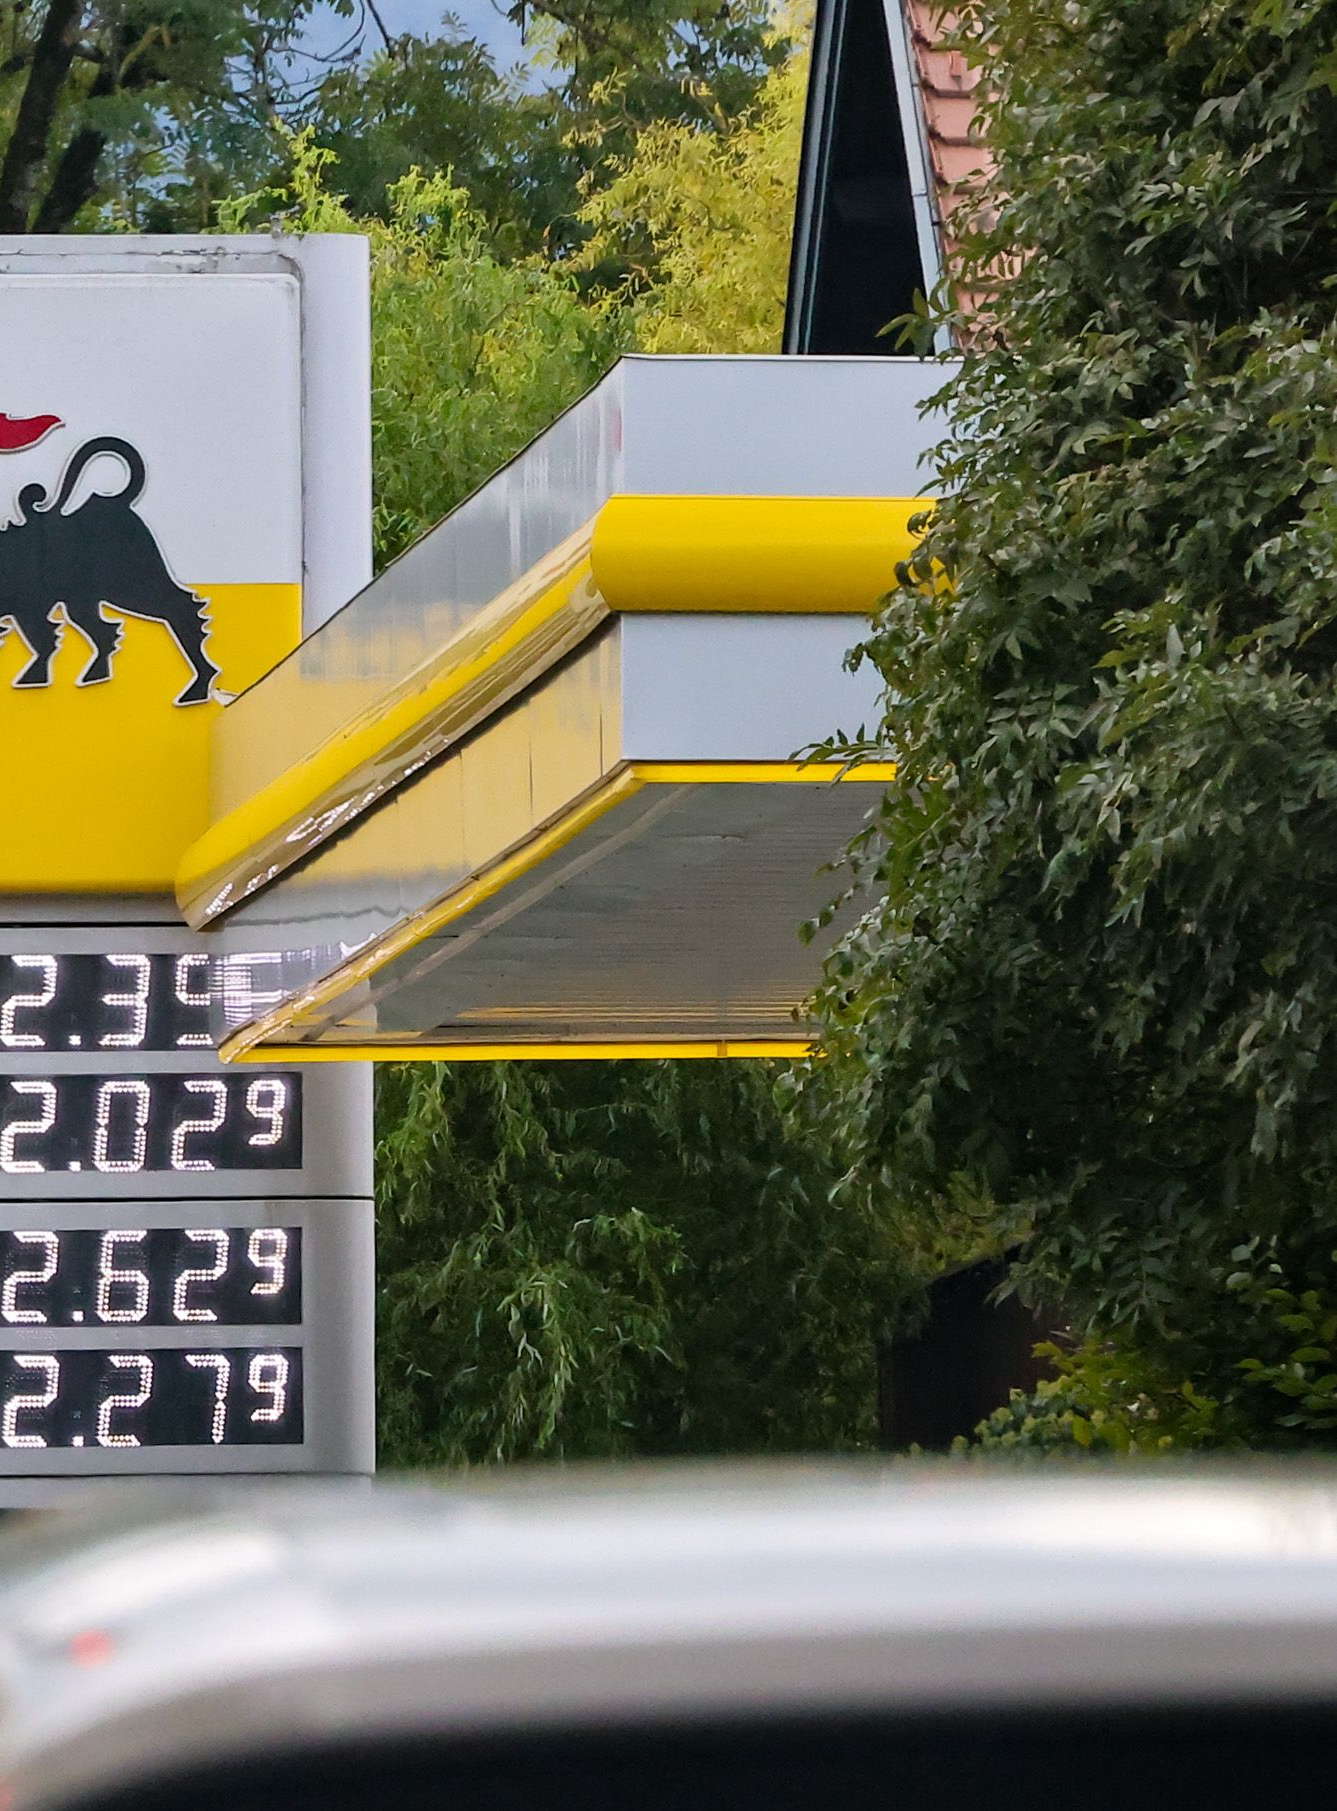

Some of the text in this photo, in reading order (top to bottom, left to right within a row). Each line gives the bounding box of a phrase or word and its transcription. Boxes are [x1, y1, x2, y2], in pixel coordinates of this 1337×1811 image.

[0, 1080, 286, 1172] 2.029
[0, 1230, 288, 1322] 2.629
[1, 1355, 289, 1447] 2.279
